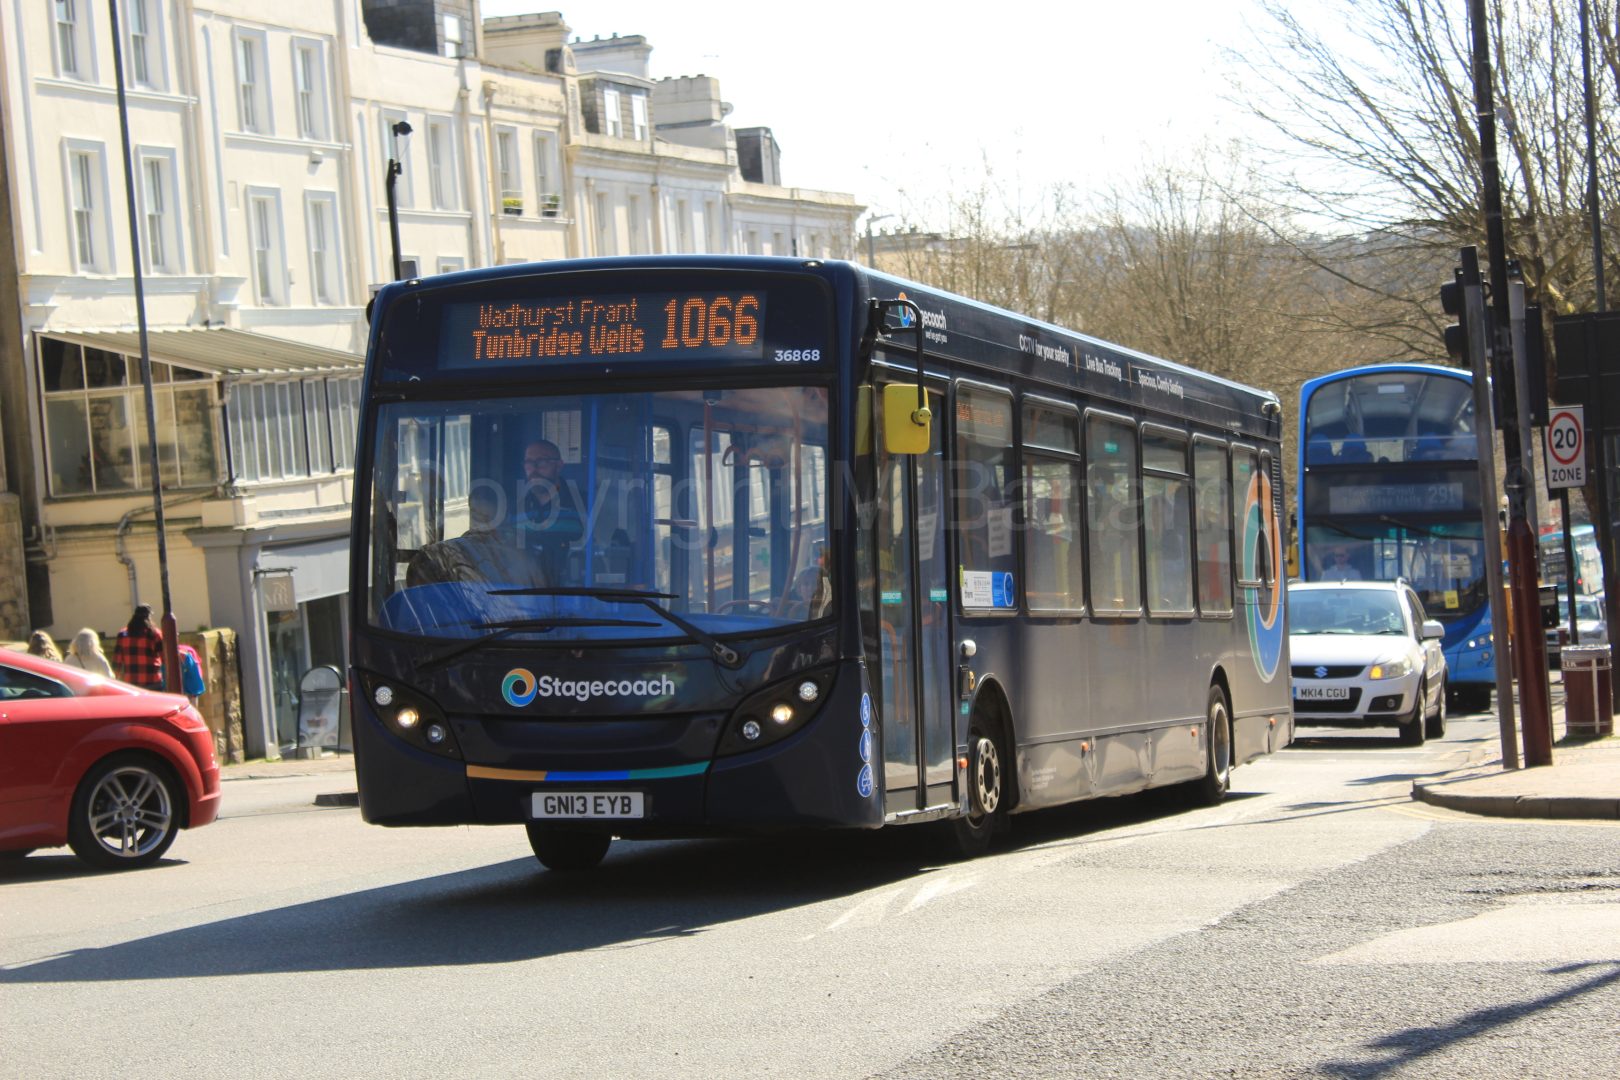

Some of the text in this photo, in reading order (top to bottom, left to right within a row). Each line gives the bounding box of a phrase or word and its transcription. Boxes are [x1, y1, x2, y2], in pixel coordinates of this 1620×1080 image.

[479, 298, 638, 328] Wadhurst Frant
[661, 295, 759, 349] 1066
[472, 323, 646, 359] Tunbridge Wells
[1019, 334, 1035, 354] CCTV
[1043, 345, 1054, 362] your
[1055, 345, 1070, 368] safety
[773, 349, 821, 362] 36868
[1085, 353, 1122, 383] Live Bus Tracking
[1553, 427, 1577, 449] 20
[1551, 467, 1582, 482] ZONE
[1428, 485, 1456, 504] 291
[538, 674, 675, 702] Stagecoach
[1301, 688, 1346, 698] MK14 CGU
[543, 795, 632, 815] GN13 EYB
